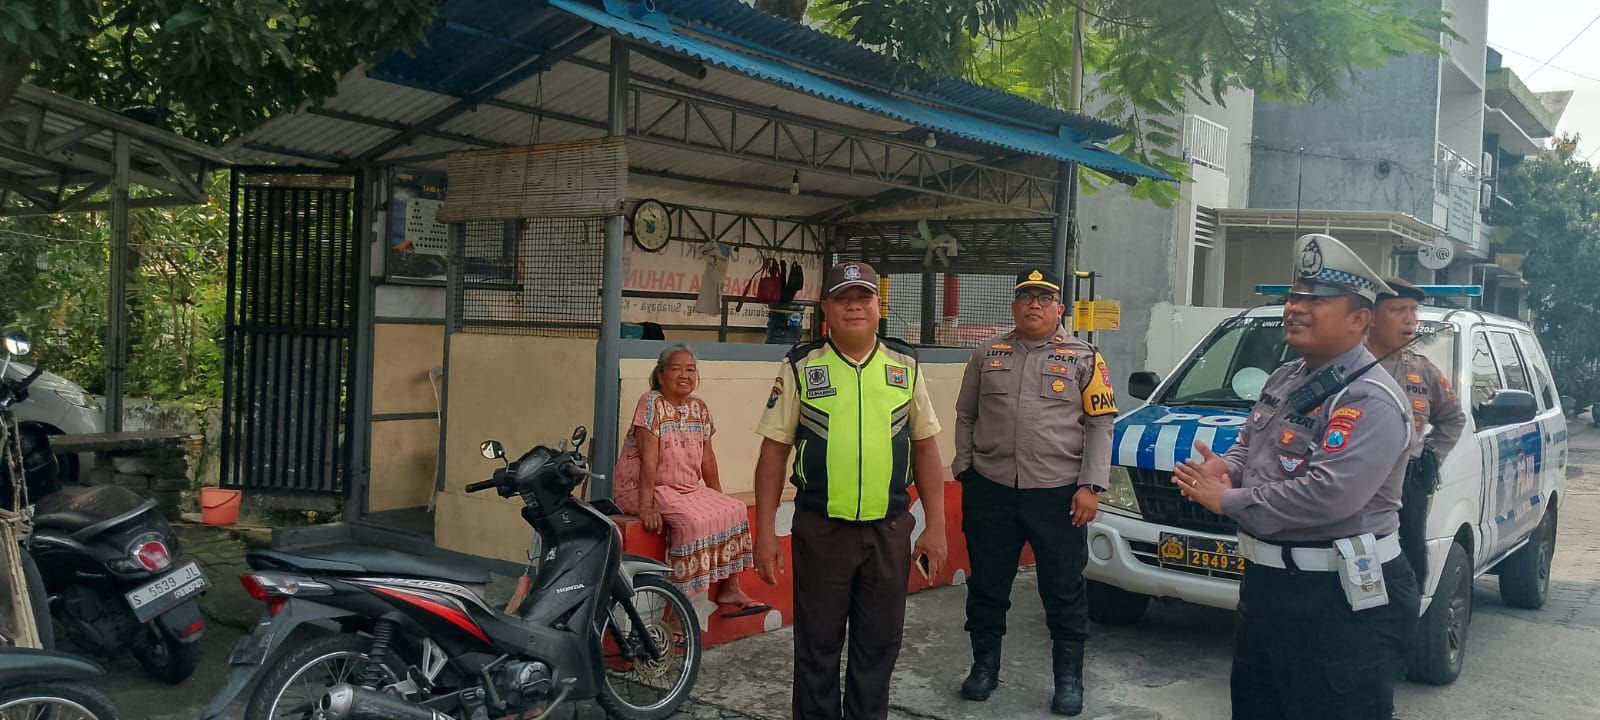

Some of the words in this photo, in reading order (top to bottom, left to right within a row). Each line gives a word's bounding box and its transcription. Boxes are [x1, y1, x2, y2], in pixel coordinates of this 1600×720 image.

[1048, 354, 1078, 365] POLRI
[1284, 412, 1316, 430] POLRI
[1216, 541, 1225, 554] X
[132, 594, 142, 606] S
[148, 576, 177, 598] 5539
[185, 566, 199, 580] JL
[555, 583, 585, 594] HONDA
